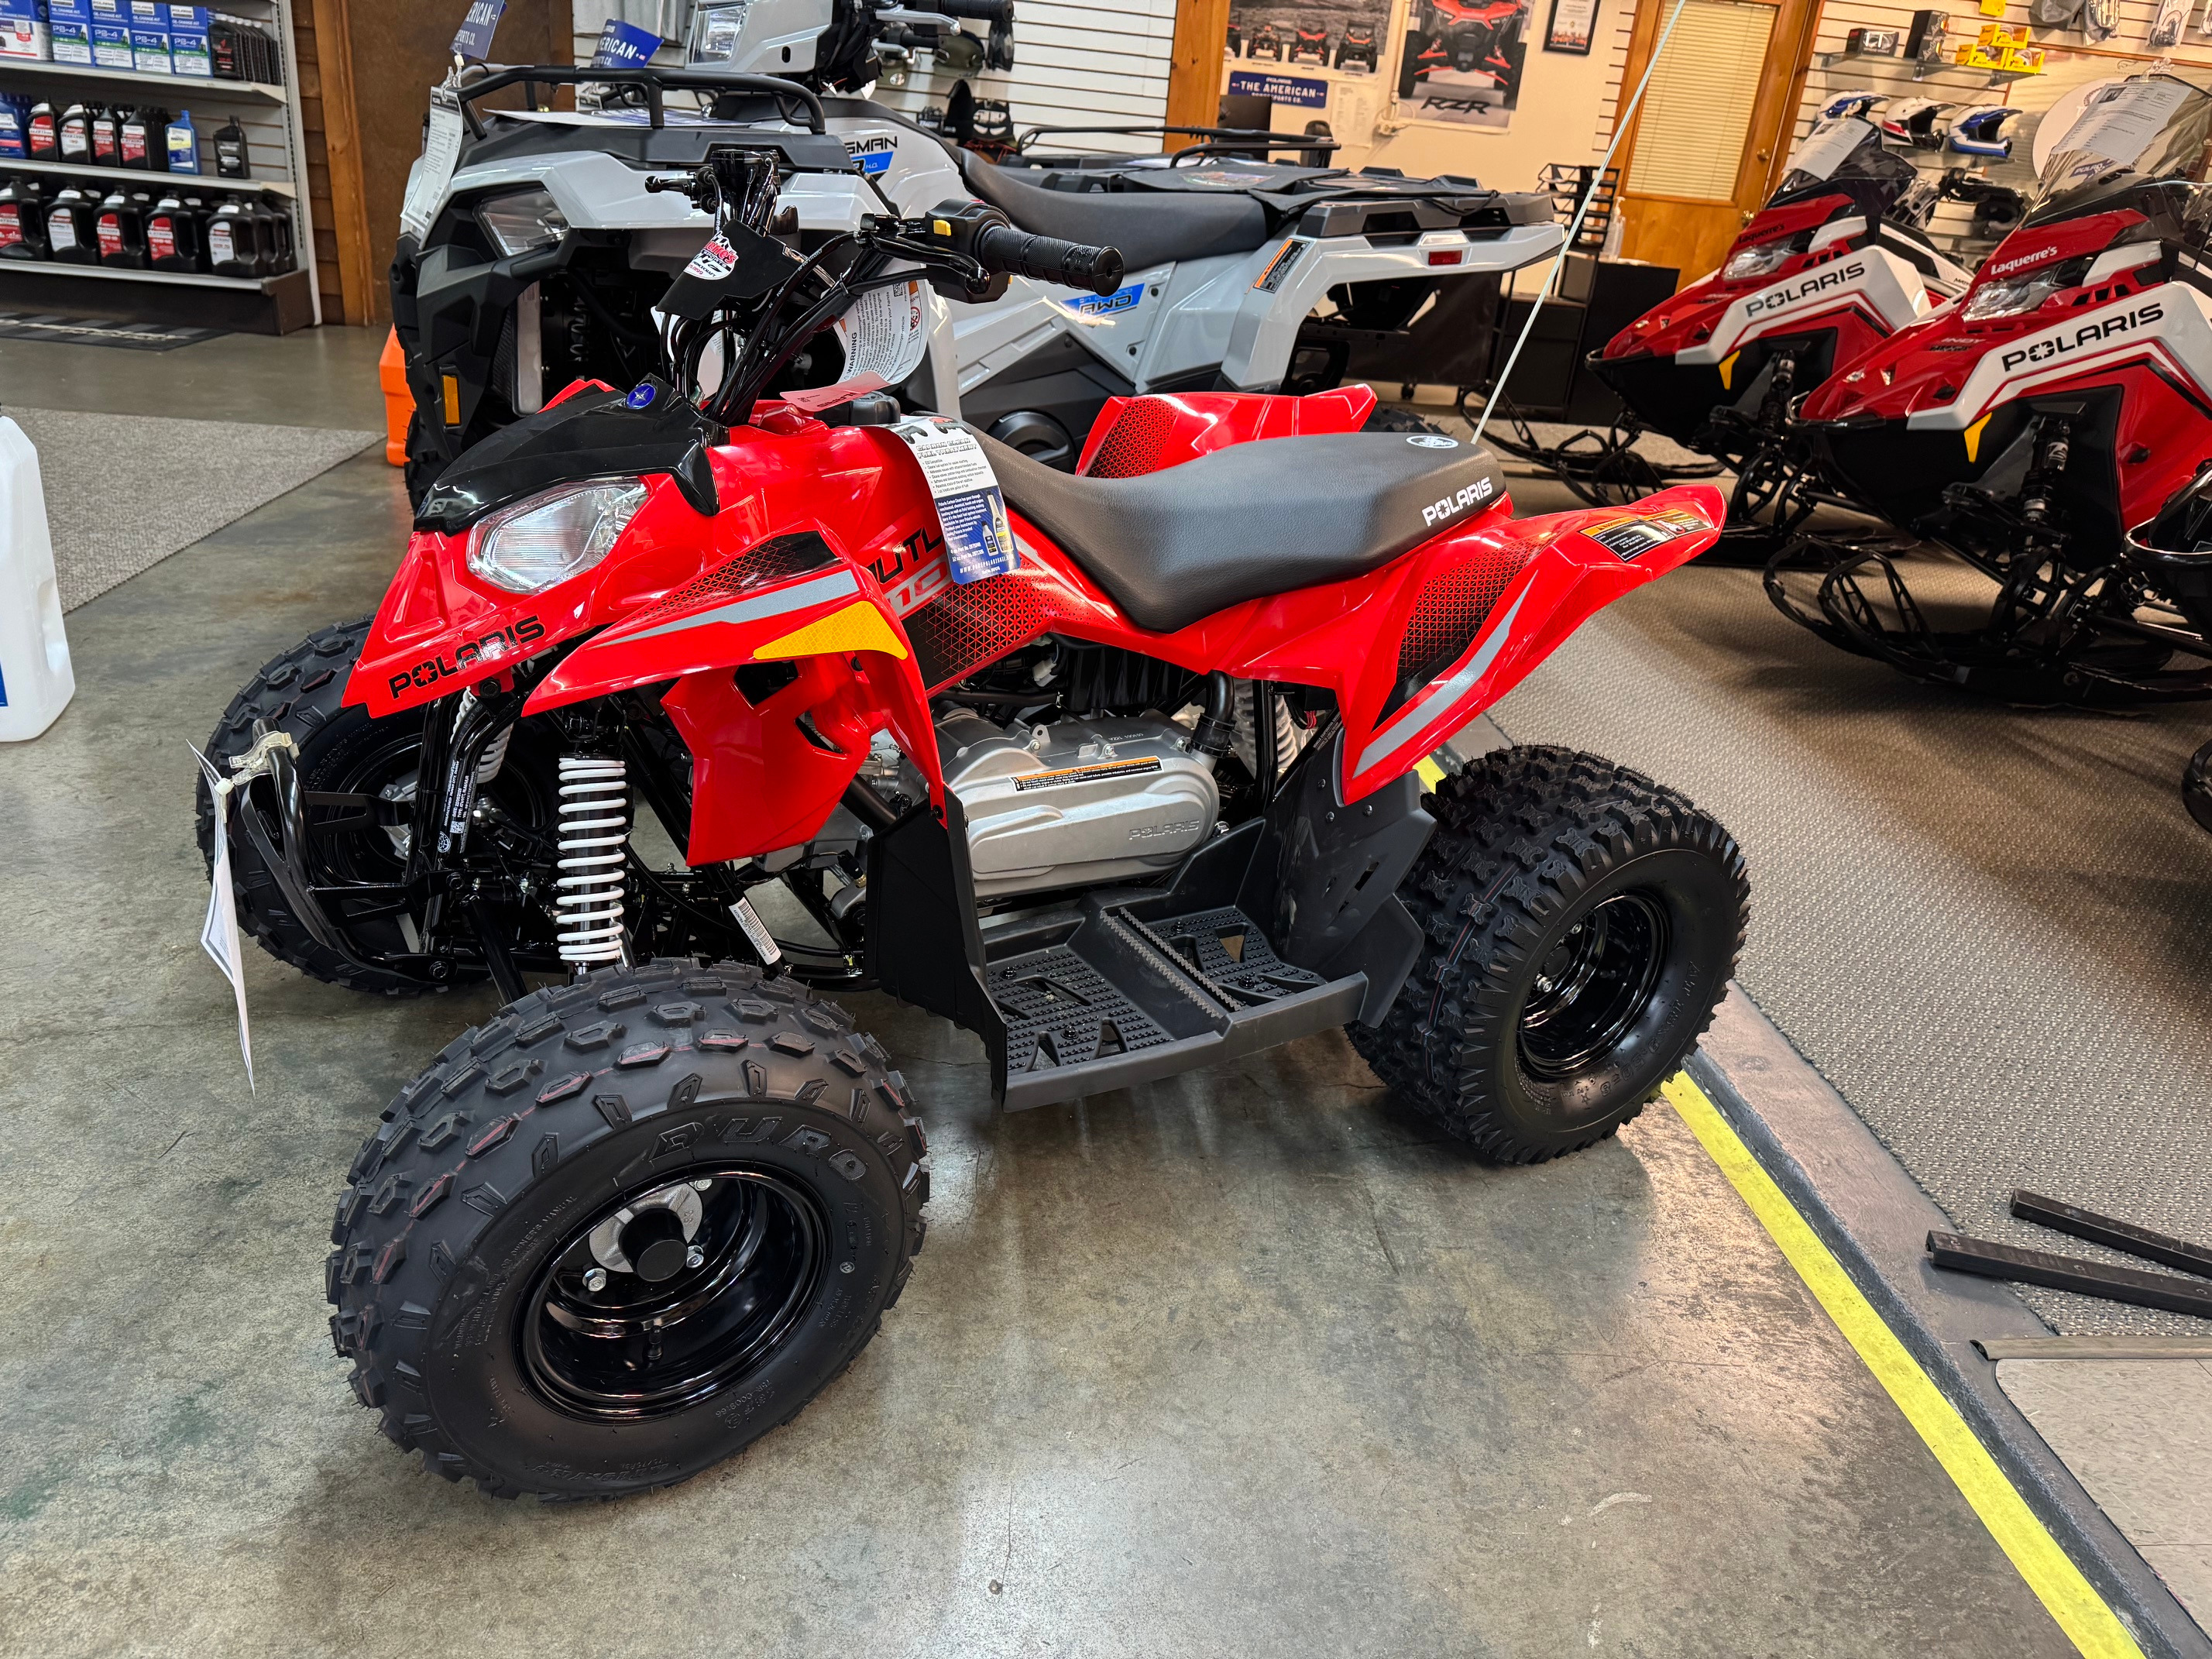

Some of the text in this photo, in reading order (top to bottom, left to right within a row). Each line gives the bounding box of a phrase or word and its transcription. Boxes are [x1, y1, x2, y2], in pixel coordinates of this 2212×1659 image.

[1241, 81, 1316, 98] THE AMERICAN
[1421, 96, 1490, 115] RZR
[1739, 224, 1784, 243] Laquerre's
[1990, 246, 2057, 275] Laquerre's
[1746, 262, 1865, 318] POLARIS
[1080, 294, 1132, 314] AWD
[2001, 302, 2164, 372] POLARIS
[846, 332, 857, 373] WARNING
[915, 437, 970, 451] CARBON CLEAN
[916, 444, 977, 459] FUEL TREATMENT
[1422, 476, 1492, 527] POLARIS
[389, 616, 544, 699] POLARIS
[1129, 819, 1200, 840] POLARIS
[647, 1117, 868, 1180] DURO
